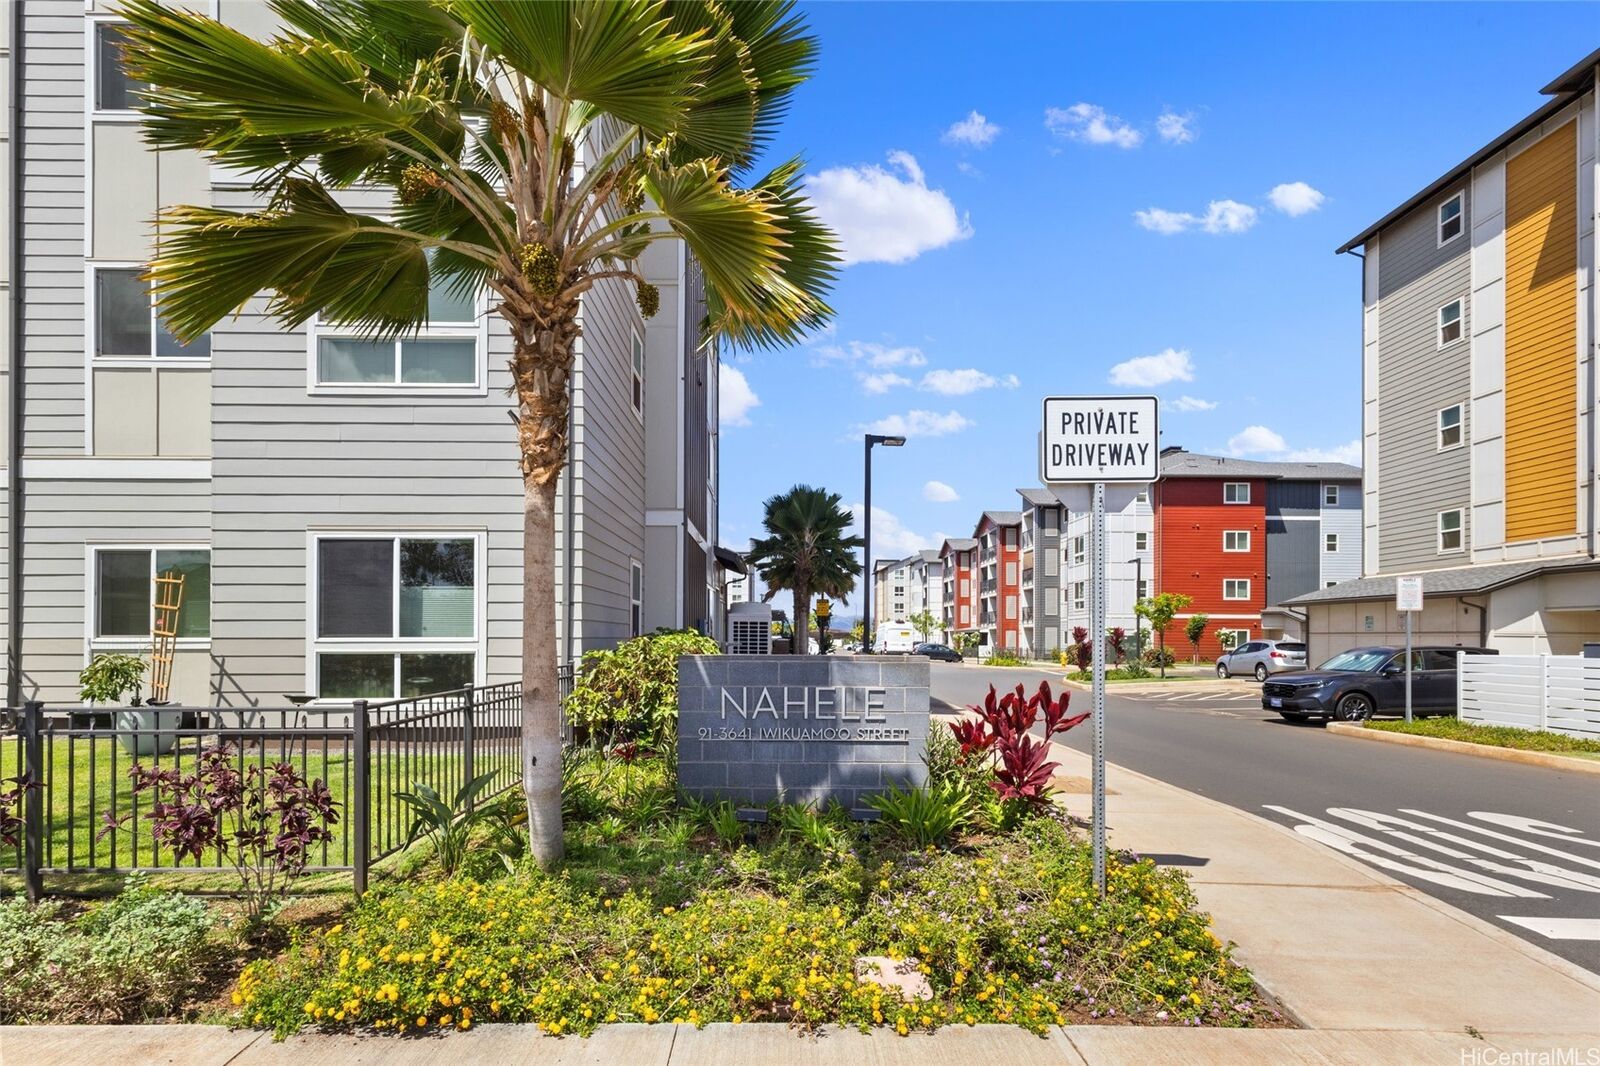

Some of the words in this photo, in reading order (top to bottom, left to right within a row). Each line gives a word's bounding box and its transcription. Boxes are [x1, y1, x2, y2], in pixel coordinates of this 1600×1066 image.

[1061, 411, 1139, 435] PRIVATE
[1052, 443, 1149, 467] DRIVEWAY
[720, 686, 886, 720] NAHELE
[698, 727, 752, 740] 91-3641
[857, 728, 910, 740] STREET
